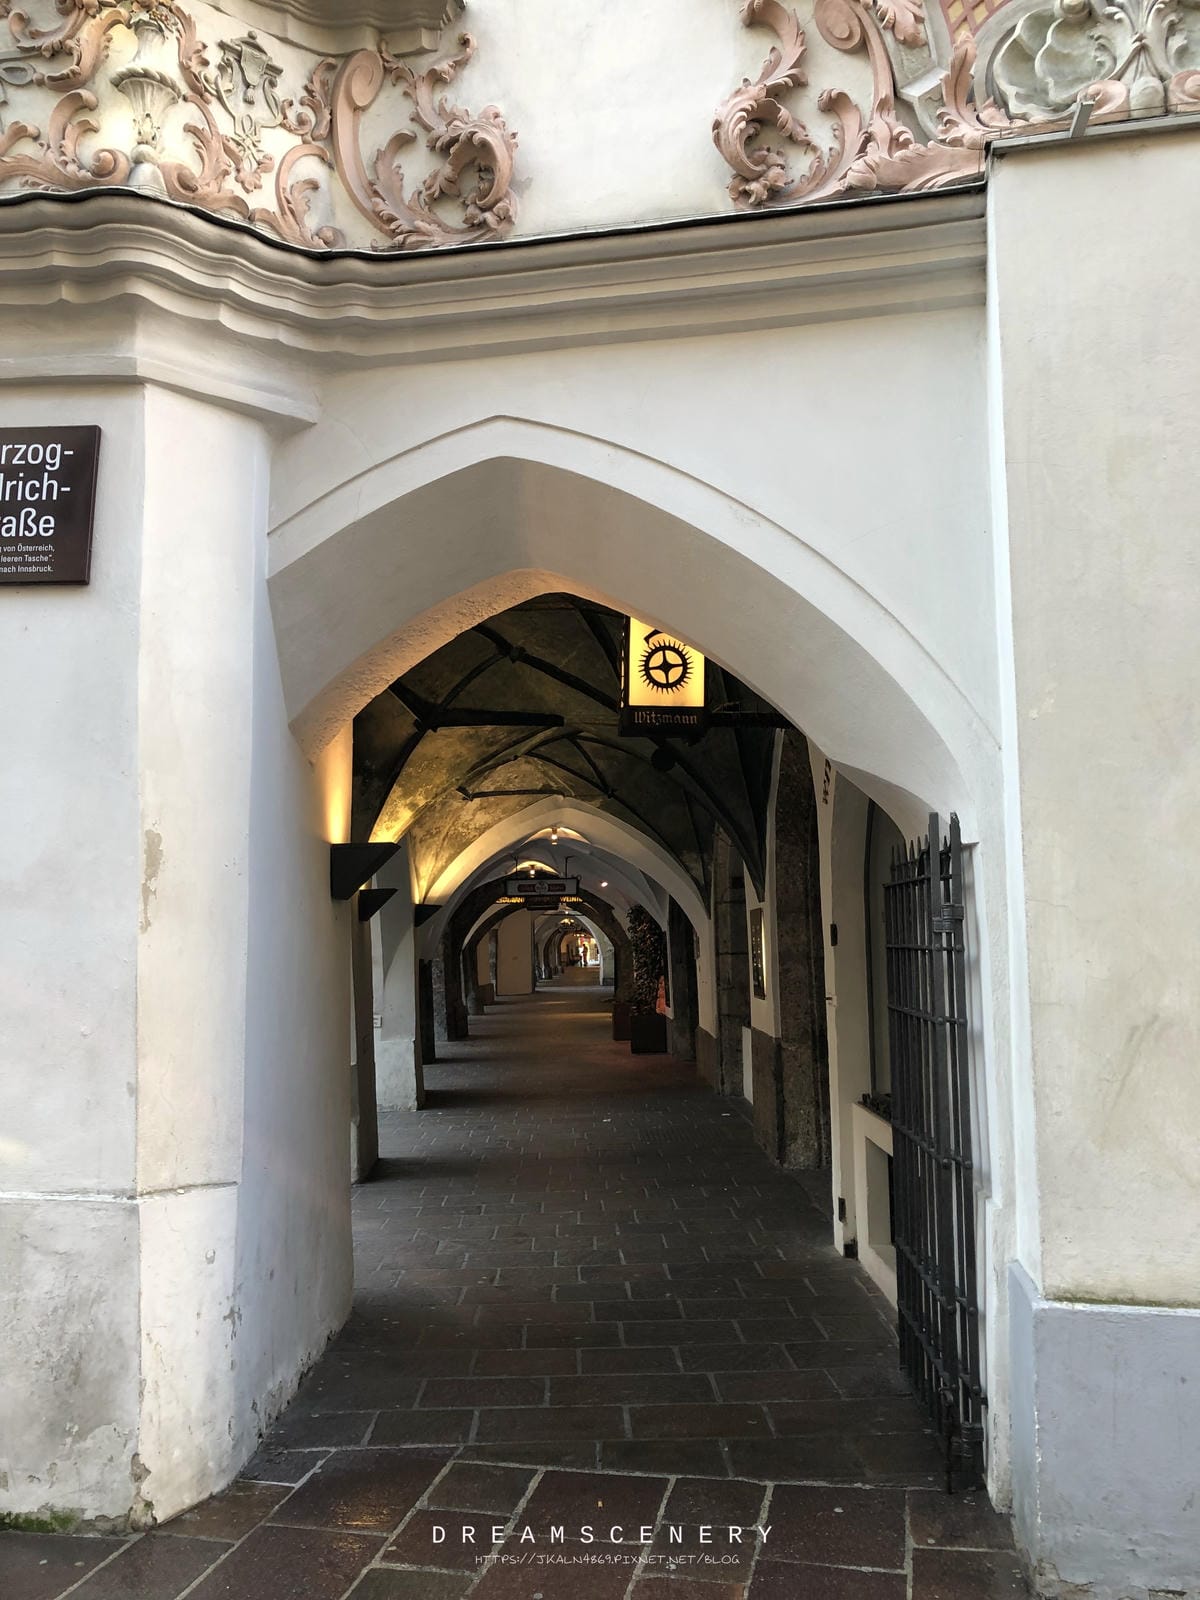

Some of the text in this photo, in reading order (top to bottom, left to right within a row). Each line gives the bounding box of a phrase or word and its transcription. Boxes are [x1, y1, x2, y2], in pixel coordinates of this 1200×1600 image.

[0, 507, 56, 538] aße
[17, 543, 56, 553] Österreich,
[634, 711, 698, 726] Witzmann
